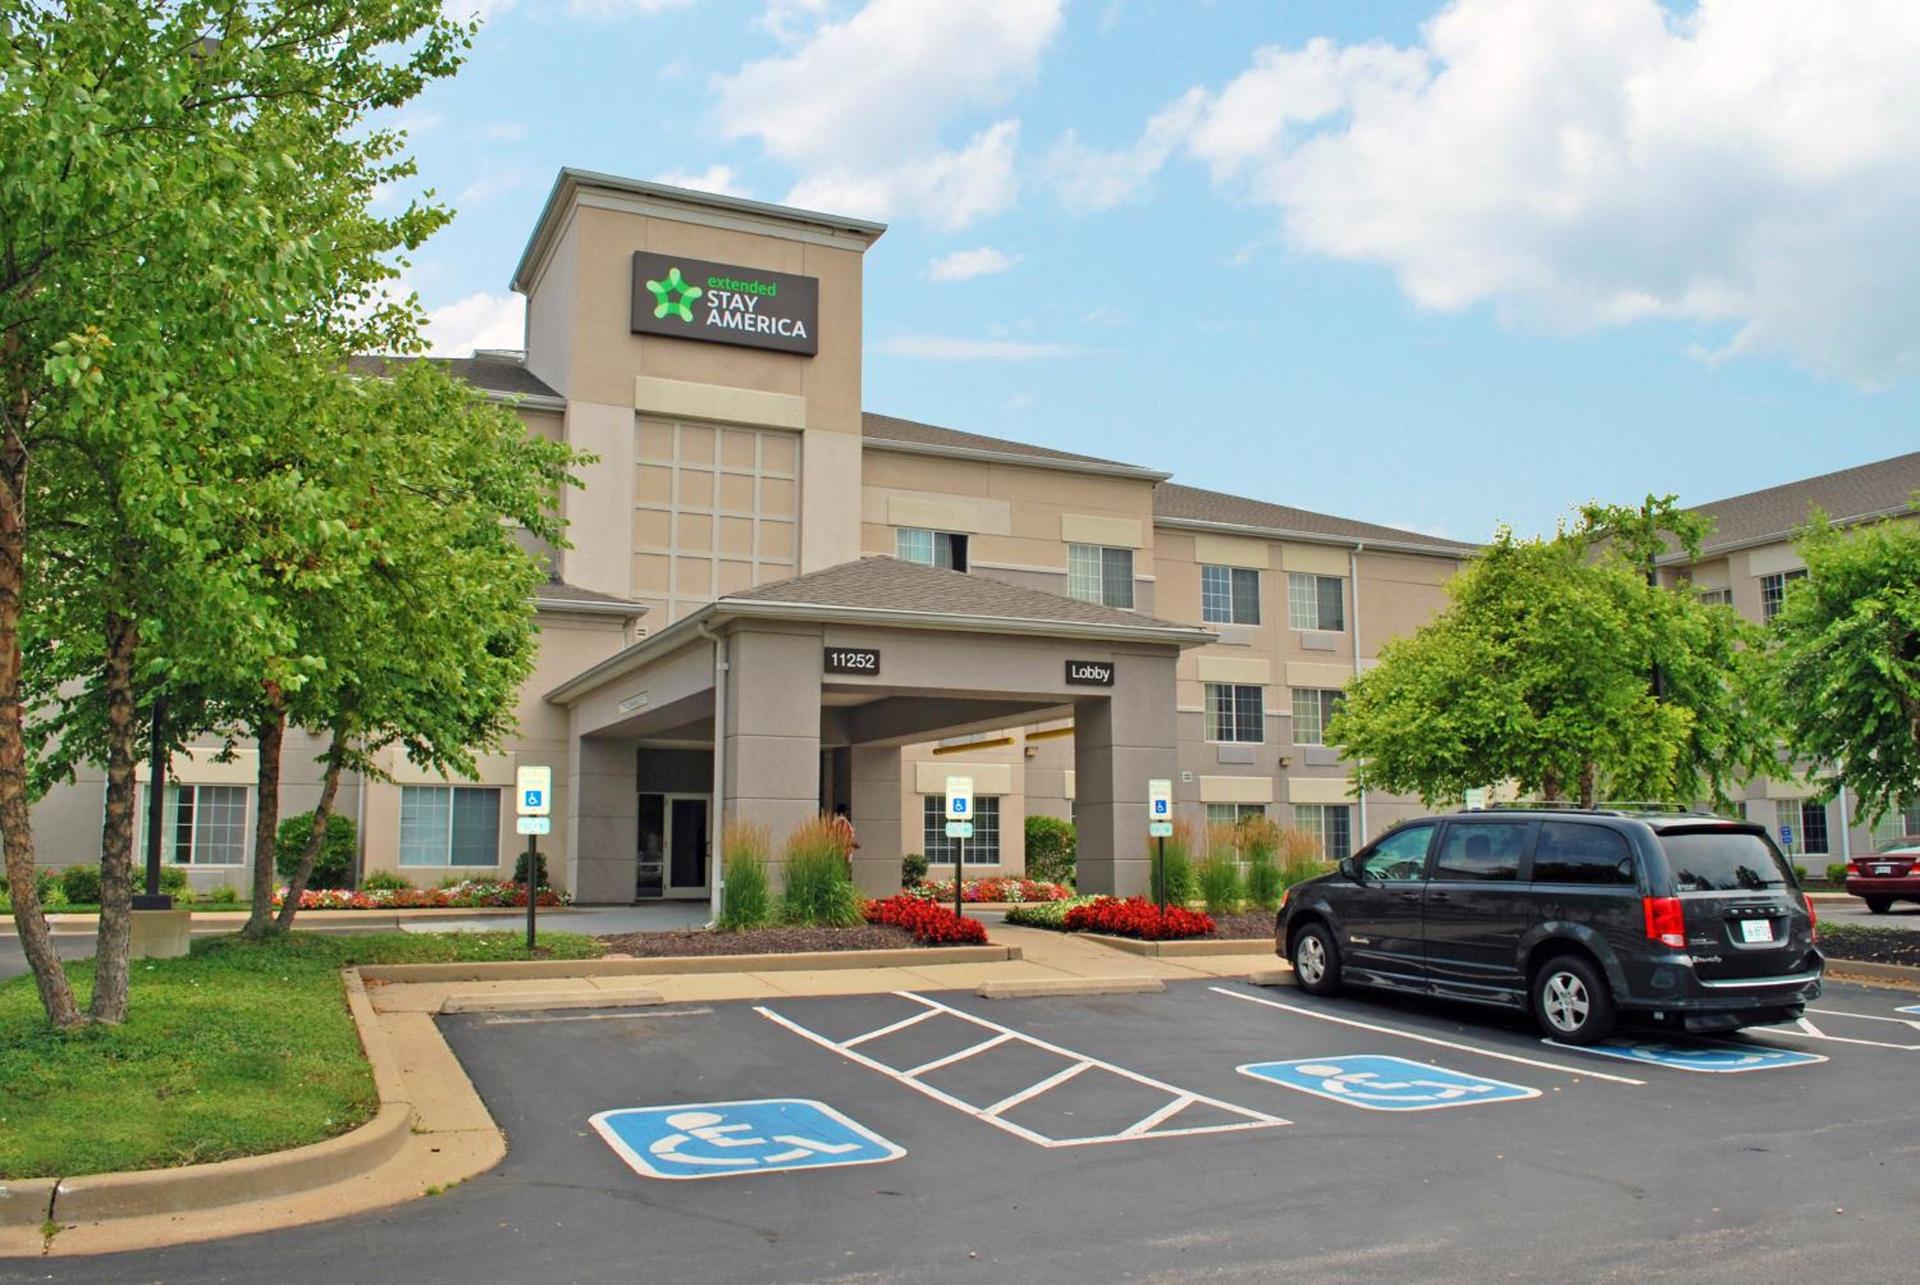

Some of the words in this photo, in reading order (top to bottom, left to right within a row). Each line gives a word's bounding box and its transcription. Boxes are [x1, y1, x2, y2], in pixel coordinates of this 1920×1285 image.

[707, 276, 777, 297] extended
[707, 290, 758, 313] STAY
[706, 309, 808, 339] AMERICA
[831, 652, 876, 669] 11252
[1071, 664, 1110, 682] Lobby
